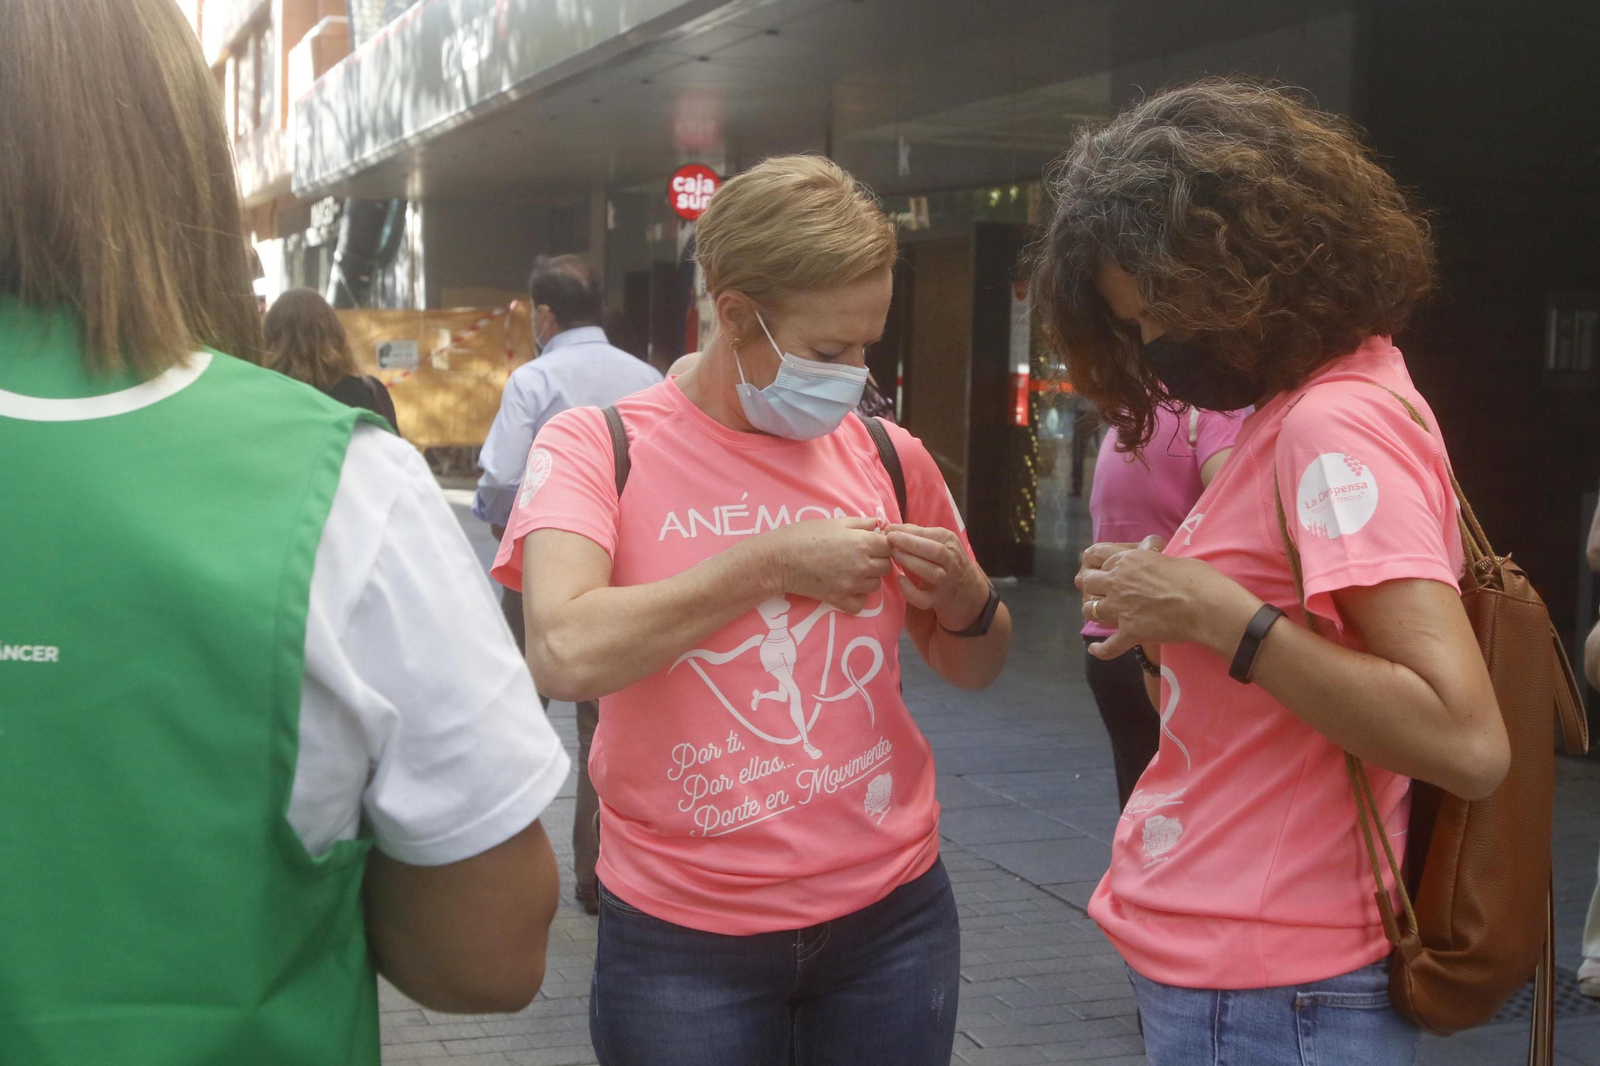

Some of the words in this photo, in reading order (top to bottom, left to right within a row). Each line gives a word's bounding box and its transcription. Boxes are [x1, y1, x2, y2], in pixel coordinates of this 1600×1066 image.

[673, 173, 715, 195] caja
[1305, 499, 1317, 510] La
[796, 736, 892, 805] Movimiento
[766, 790, 789, 810] en
